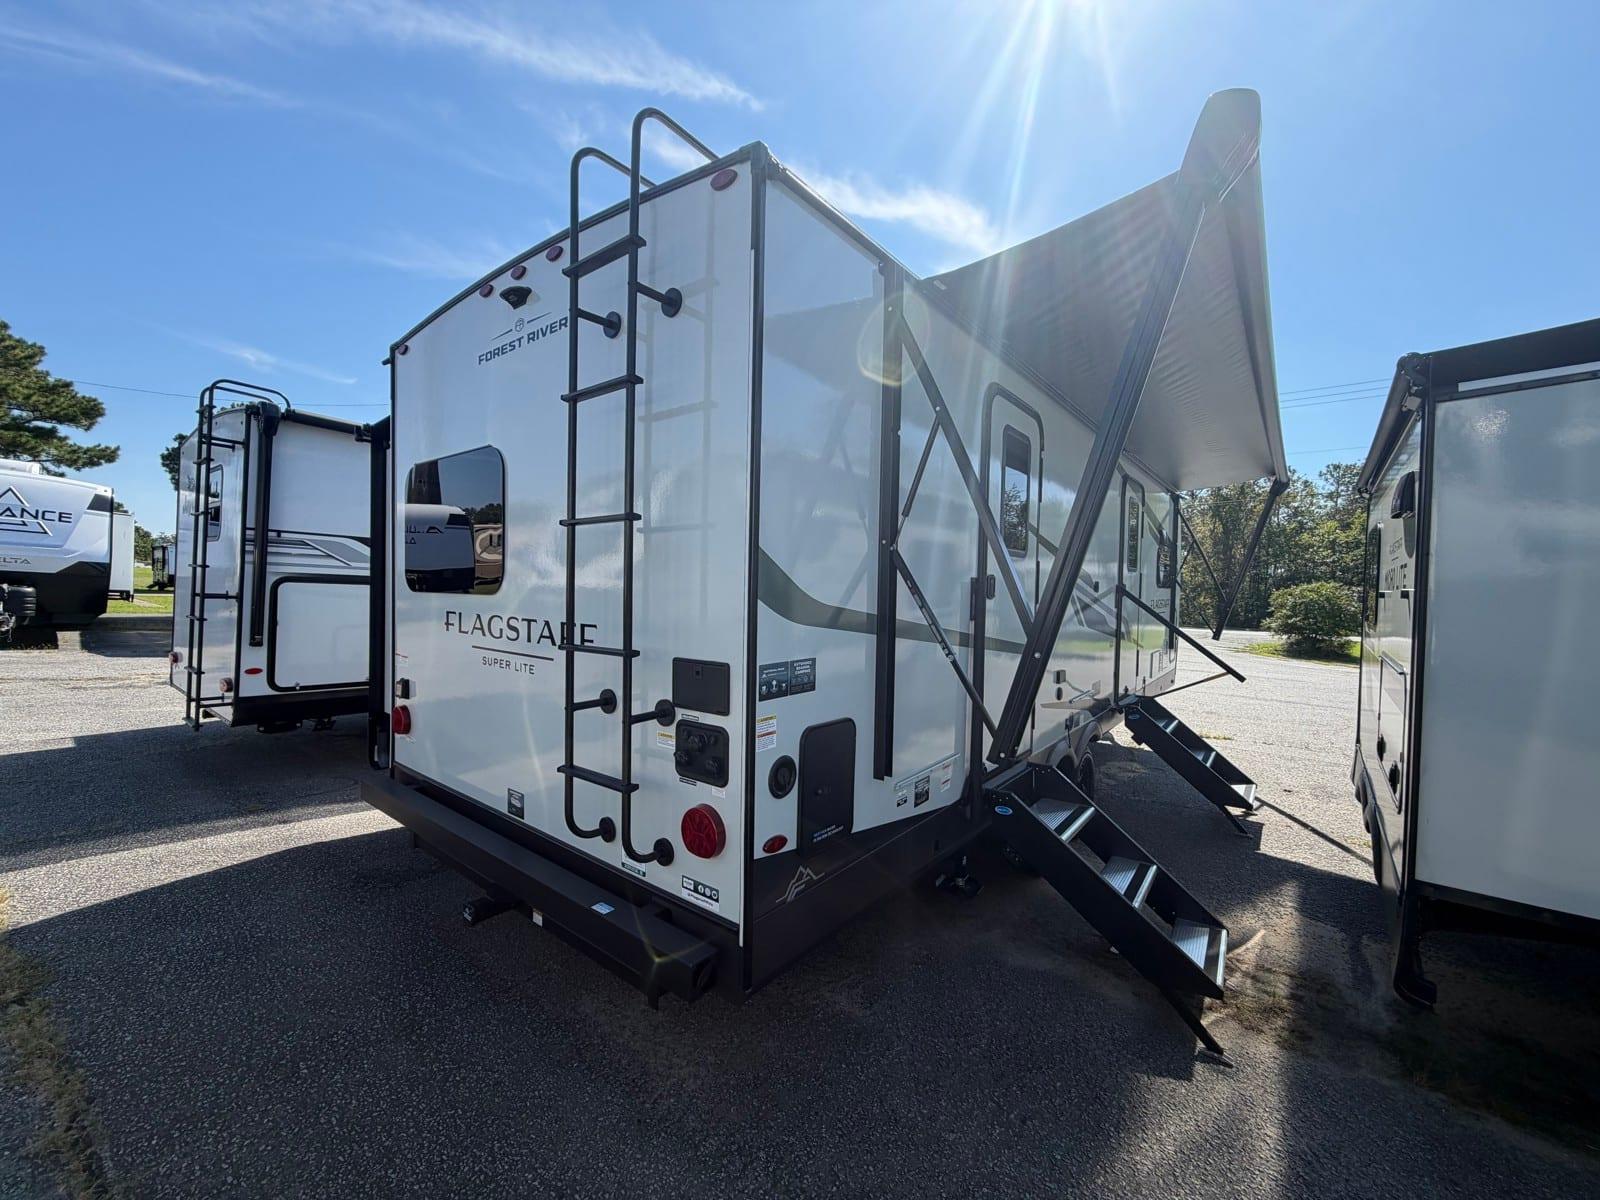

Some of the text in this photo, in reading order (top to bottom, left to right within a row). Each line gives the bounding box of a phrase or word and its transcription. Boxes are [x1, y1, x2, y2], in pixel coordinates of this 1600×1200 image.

[478, 316, 569, 365] FOREST RIVER
[0, 506, 73, 524] ANCE
[482, 656, 536, 675] SUPER LITE
